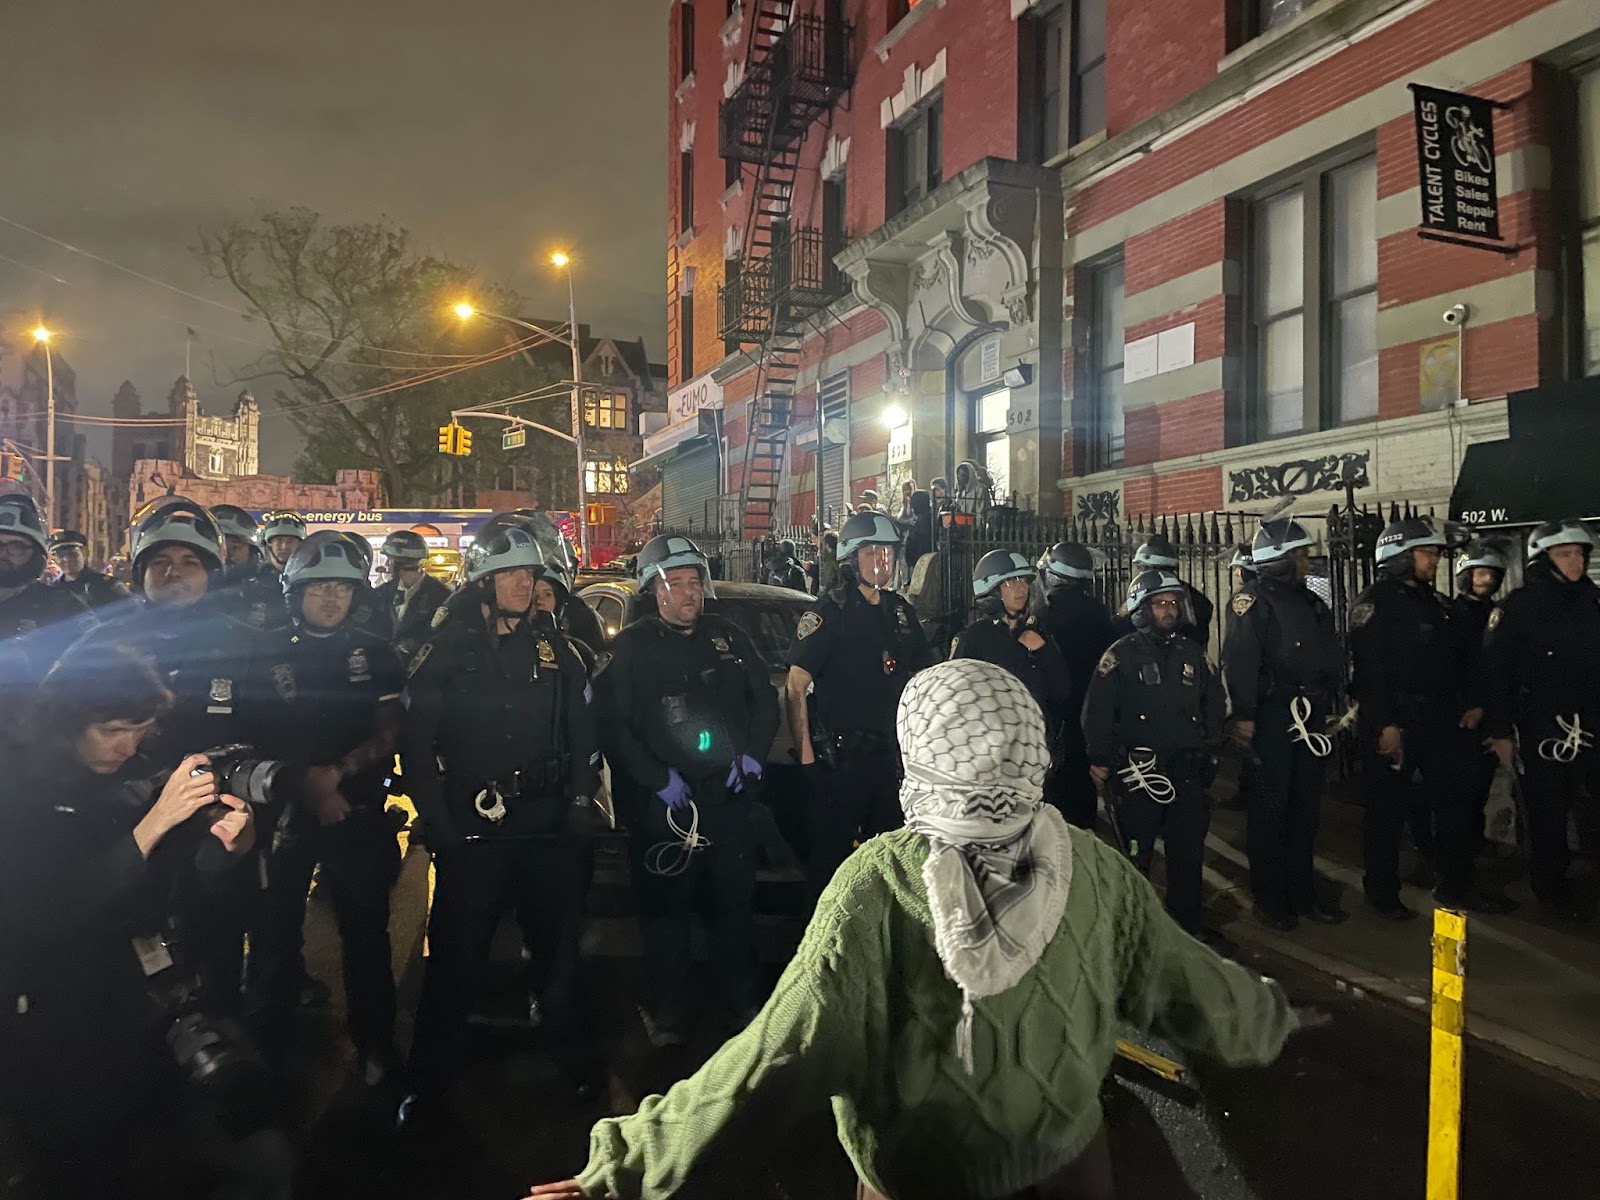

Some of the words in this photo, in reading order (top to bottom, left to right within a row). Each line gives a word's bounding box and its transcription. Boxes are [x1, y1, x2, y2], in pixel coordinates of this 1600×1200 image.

[1421, 101, 1441, 160] CYCLES
[1454, 169, 1490, 187] Bikes
[1426, 163, 1445, 224] TALENT
[1455, 185, 1490, 202] Sales
[1456, 201, 1496, 219] Repair
[1457, 216, 1488, 233] Rent
[681, 383, 708, 417] FUMO
[1009, 409, 1032, 426] 502
[357, 511, 383, 522] bus
[1461, 510, 1486, 524] 502
[1491, 508, 1509, 522] W.
